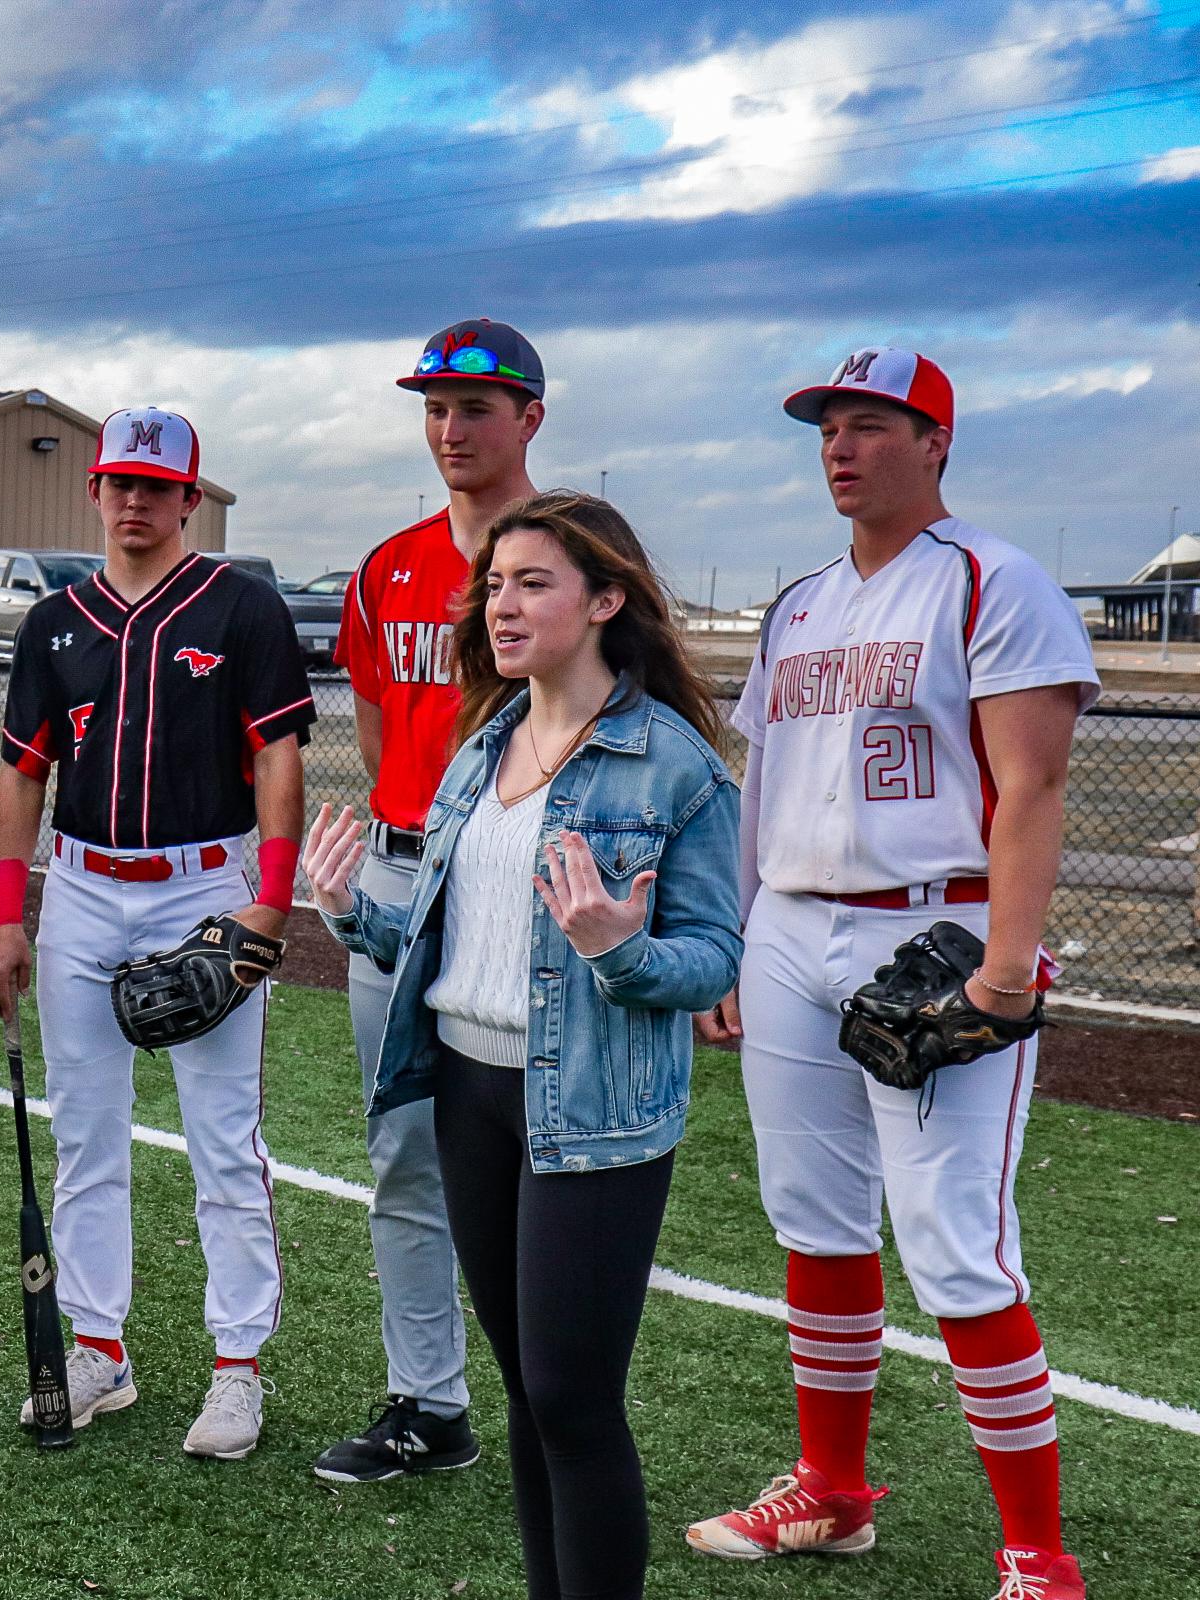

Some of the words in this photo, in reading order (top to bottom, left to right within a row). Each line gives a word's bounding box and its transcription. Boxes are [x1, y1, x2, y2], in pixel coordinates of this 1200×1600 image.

[832, 351, 879, 387] M
[126, 420, 163, 455] M
[767, 641, 925, 724] MUSTANGS
[863, 724, 936, 801] 21
[776, 1517, 836, 1553] NIKE
